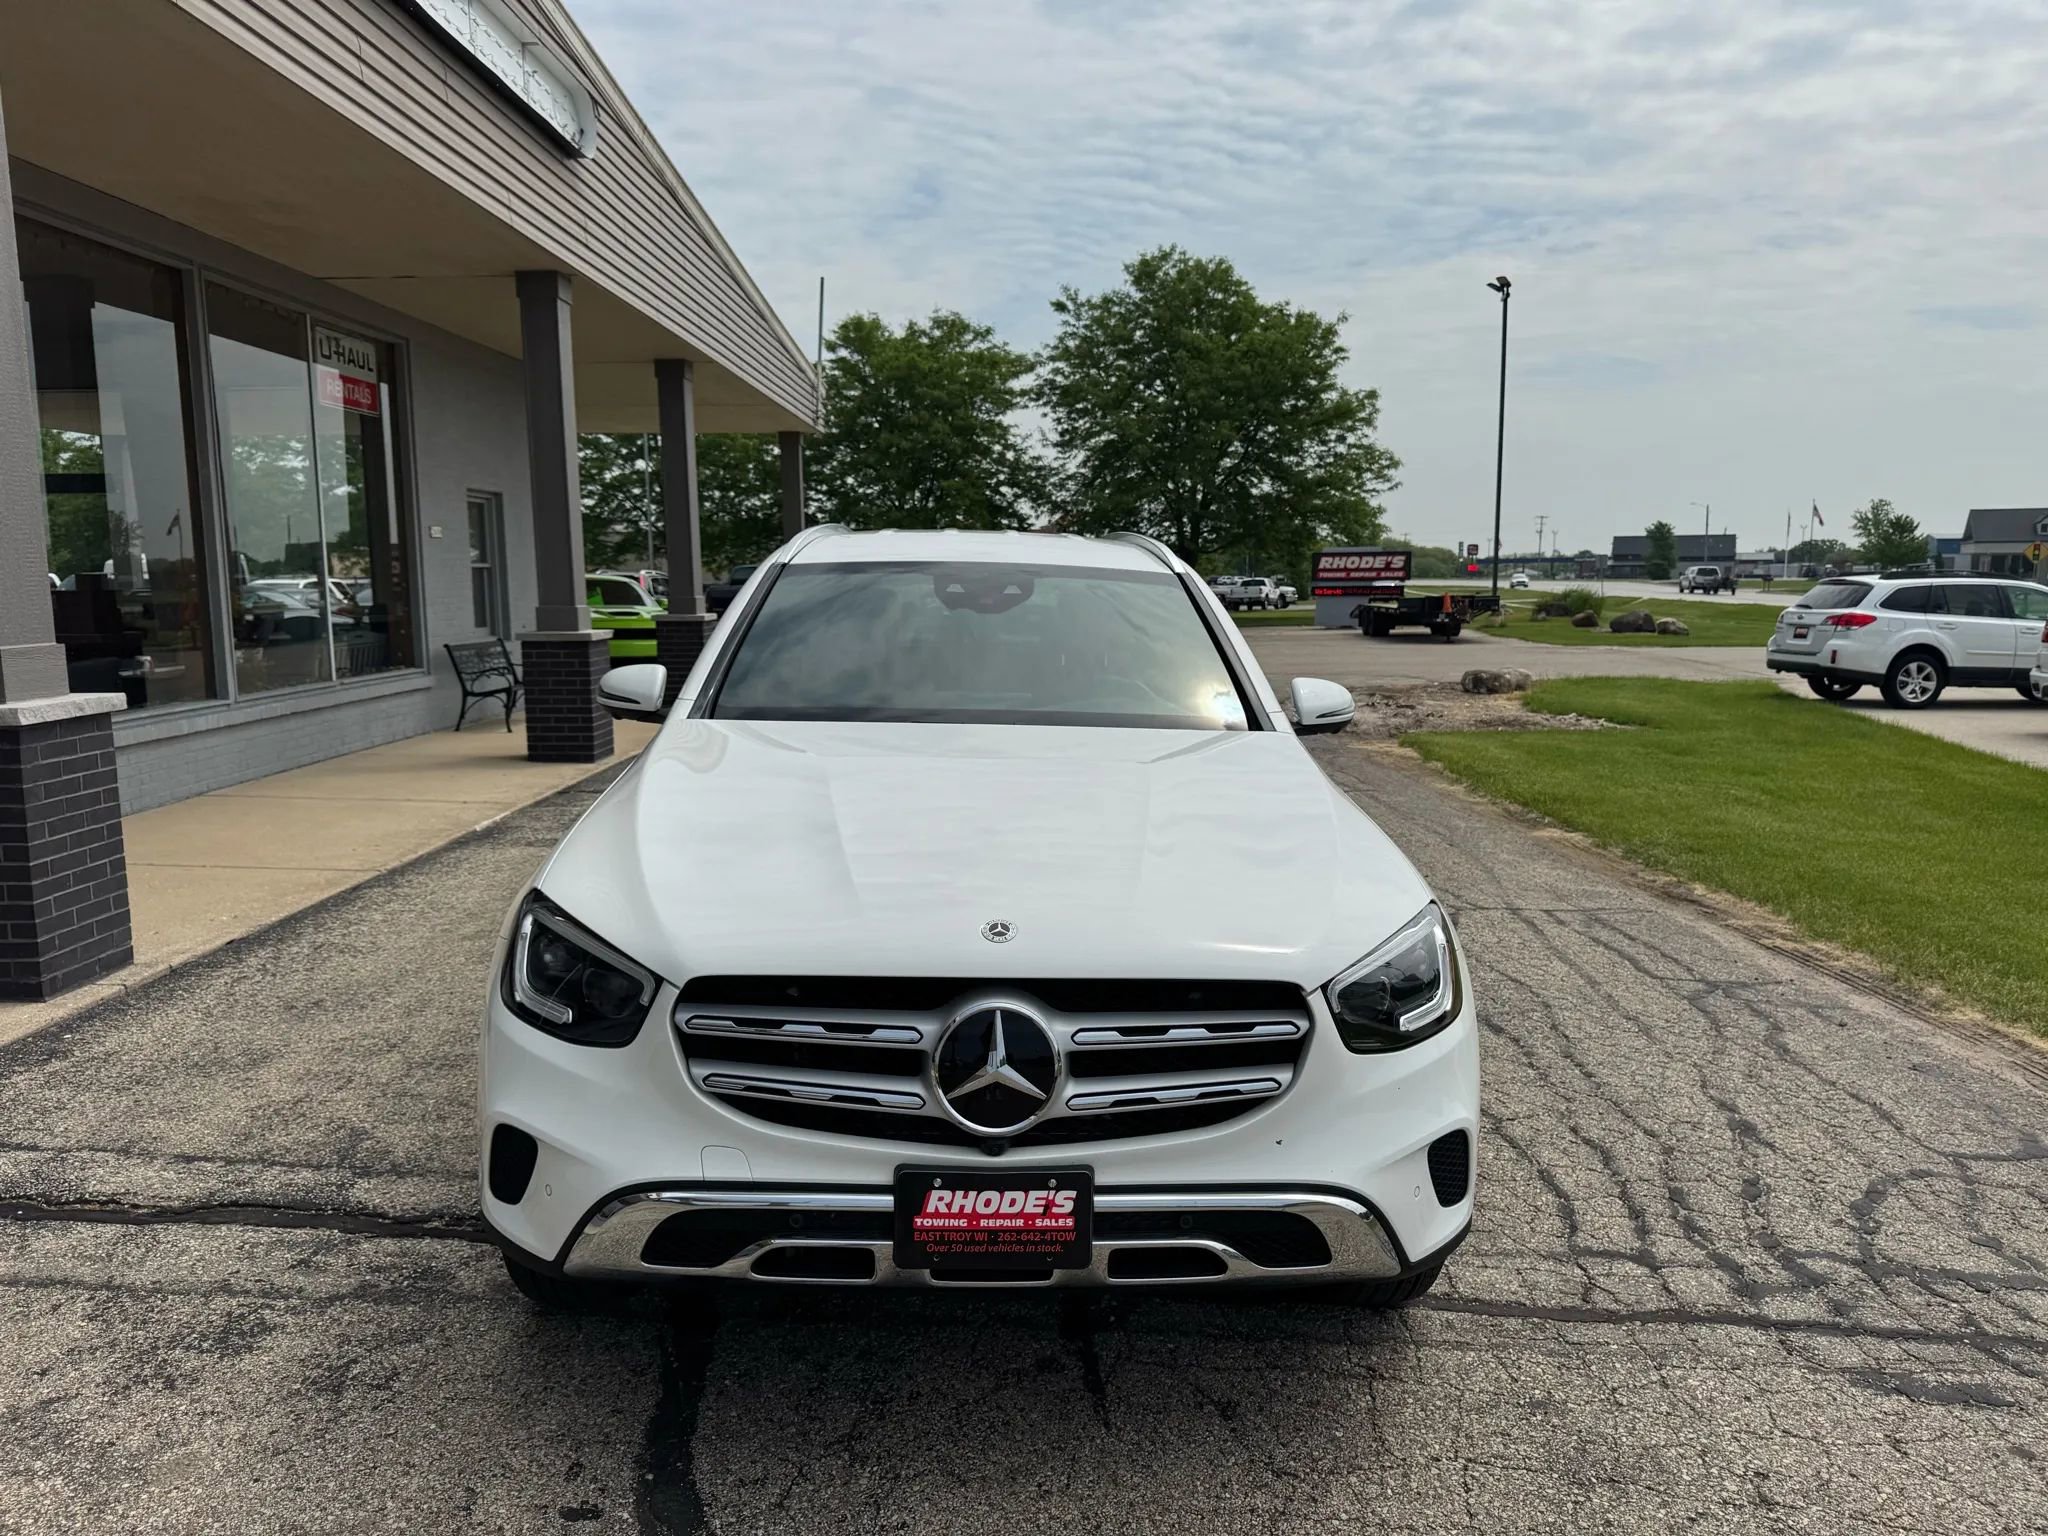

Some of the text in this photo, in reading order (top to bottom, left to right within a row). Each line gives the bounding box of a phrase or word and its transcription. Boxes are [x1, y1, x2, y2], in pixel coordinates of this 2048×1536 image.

[319, 336, 374, 372] U-HAUL
[326, 378, 372, 404] RENTALS
[1318, 555, 1406, 569] RHODE'S
[926, 1190, 1078, 1214] RHODE'S
[914, 1218, 1073, 1227] TOWING REPAIR SALES
[914, 1231, 1077, 1241] EAST TROY WI 262-642-4TOW
[926, 1243, 1064, 1252] Over 50 used vehicles in stock.
